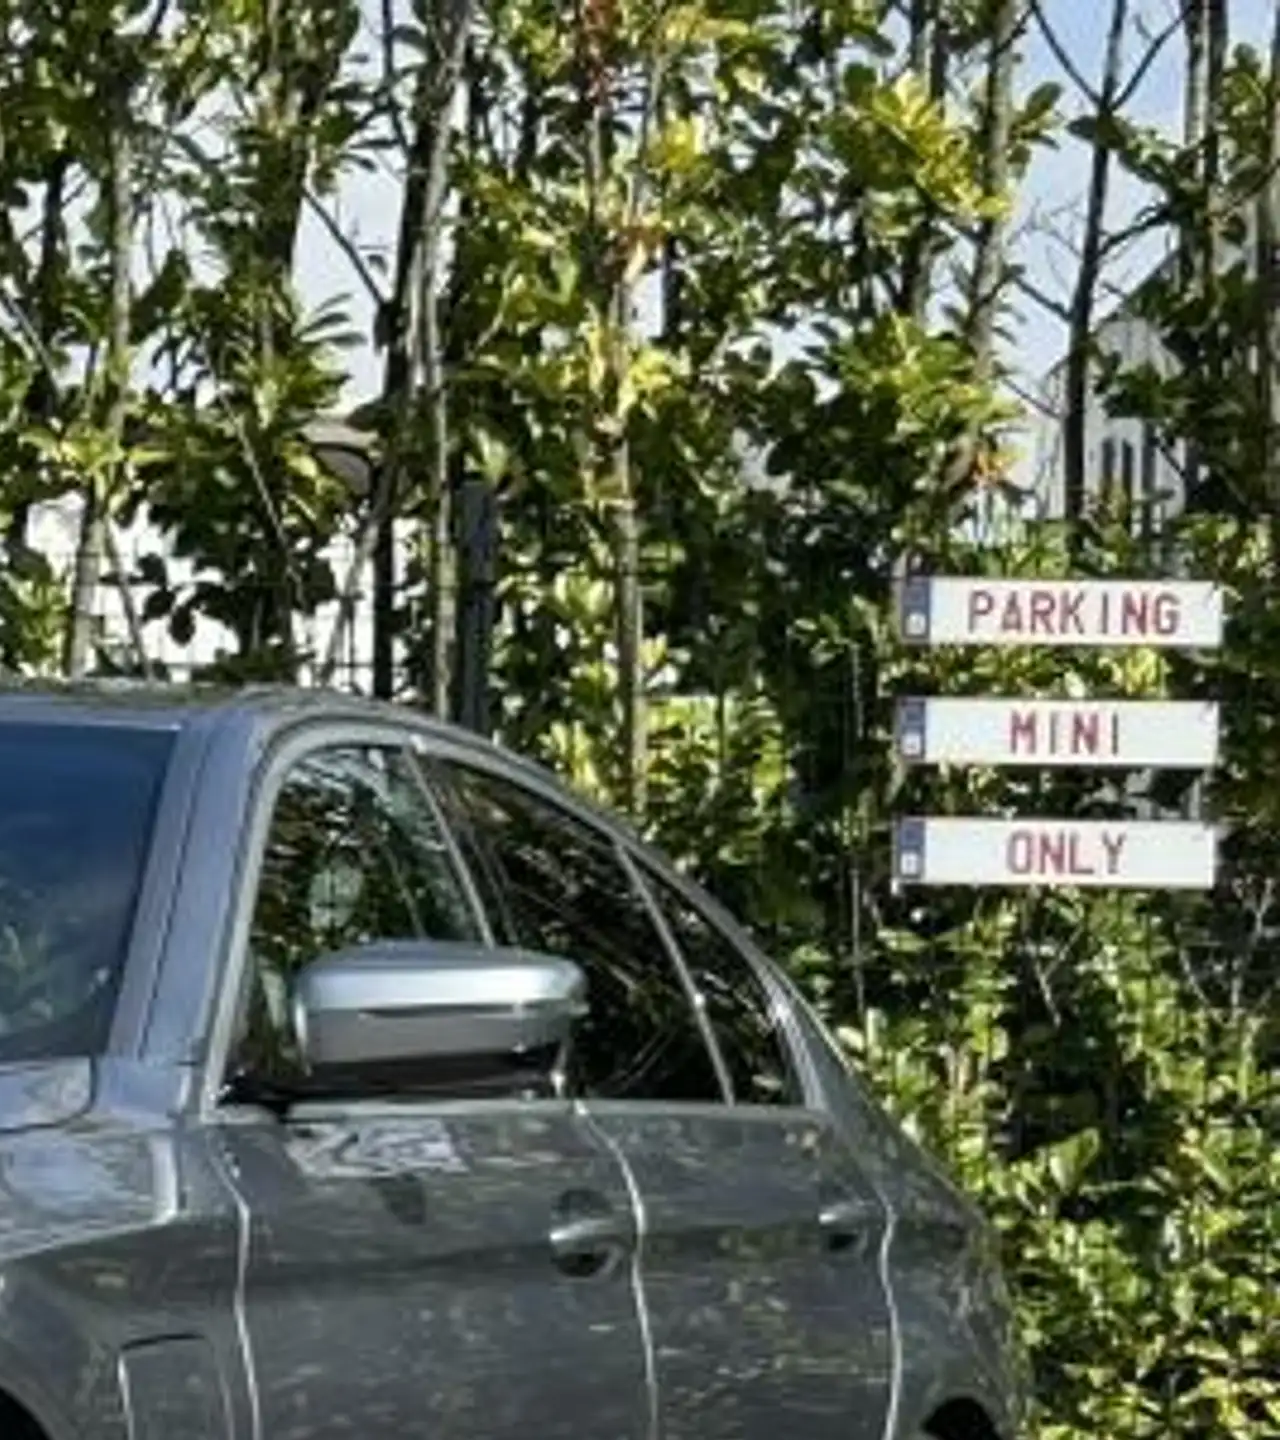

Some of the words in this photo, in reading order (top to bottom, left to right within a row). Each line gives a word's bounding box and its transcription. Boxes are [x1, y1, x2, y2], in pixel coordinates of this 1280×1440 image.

[967, 589, 1181, 636] PARKING
[1009, 710, 1120, 754] MINI
[1005, 829, 1127, 876] ONLY
